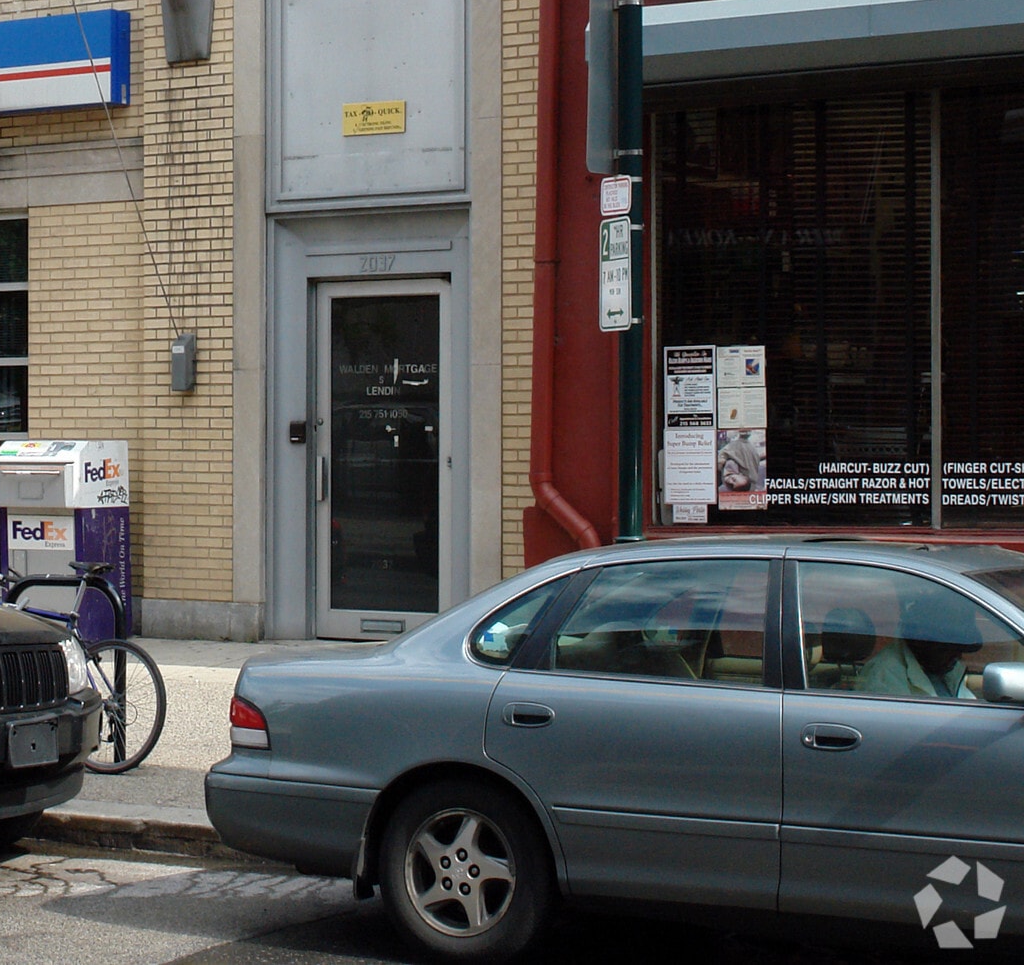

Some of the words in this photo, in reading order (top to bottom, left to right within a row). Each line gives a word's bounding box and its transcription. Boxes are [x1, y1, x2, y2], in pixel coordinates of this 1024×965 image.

[602, 229, 609, 256] 2
[360, 256, 396, 272] 2037
[339, 364, 379, 374] WALDEN
[384, 364, 437, 373] MRTGAGE
[84, 458, 120, 483] FedEx
[904, 462, 930, 474] CUT)
[943, 462, 987, 474] (FINGER
[989, 462, 1024, 474] CUT-S
[764, 477, 860, 490] FACIALS/STRAIGHT
[861, 477, 898, 489] RAZOR
[899, 478, 906, 489] &
[908, 477, 931, 489] HOT
[942, 478, 1024, 491] TOWELS/ELECT
[749, 494, 792, 506] CLIPPER
[793, 493, 857, 506] SHAVE/SKIN
[859, 493, 930, 505] TREATMENTS
[942, 494, 1024, 506] DREADS/TWIST
[12, 521, 67, 541] FedEx
[119, 545, 125, 559] On
